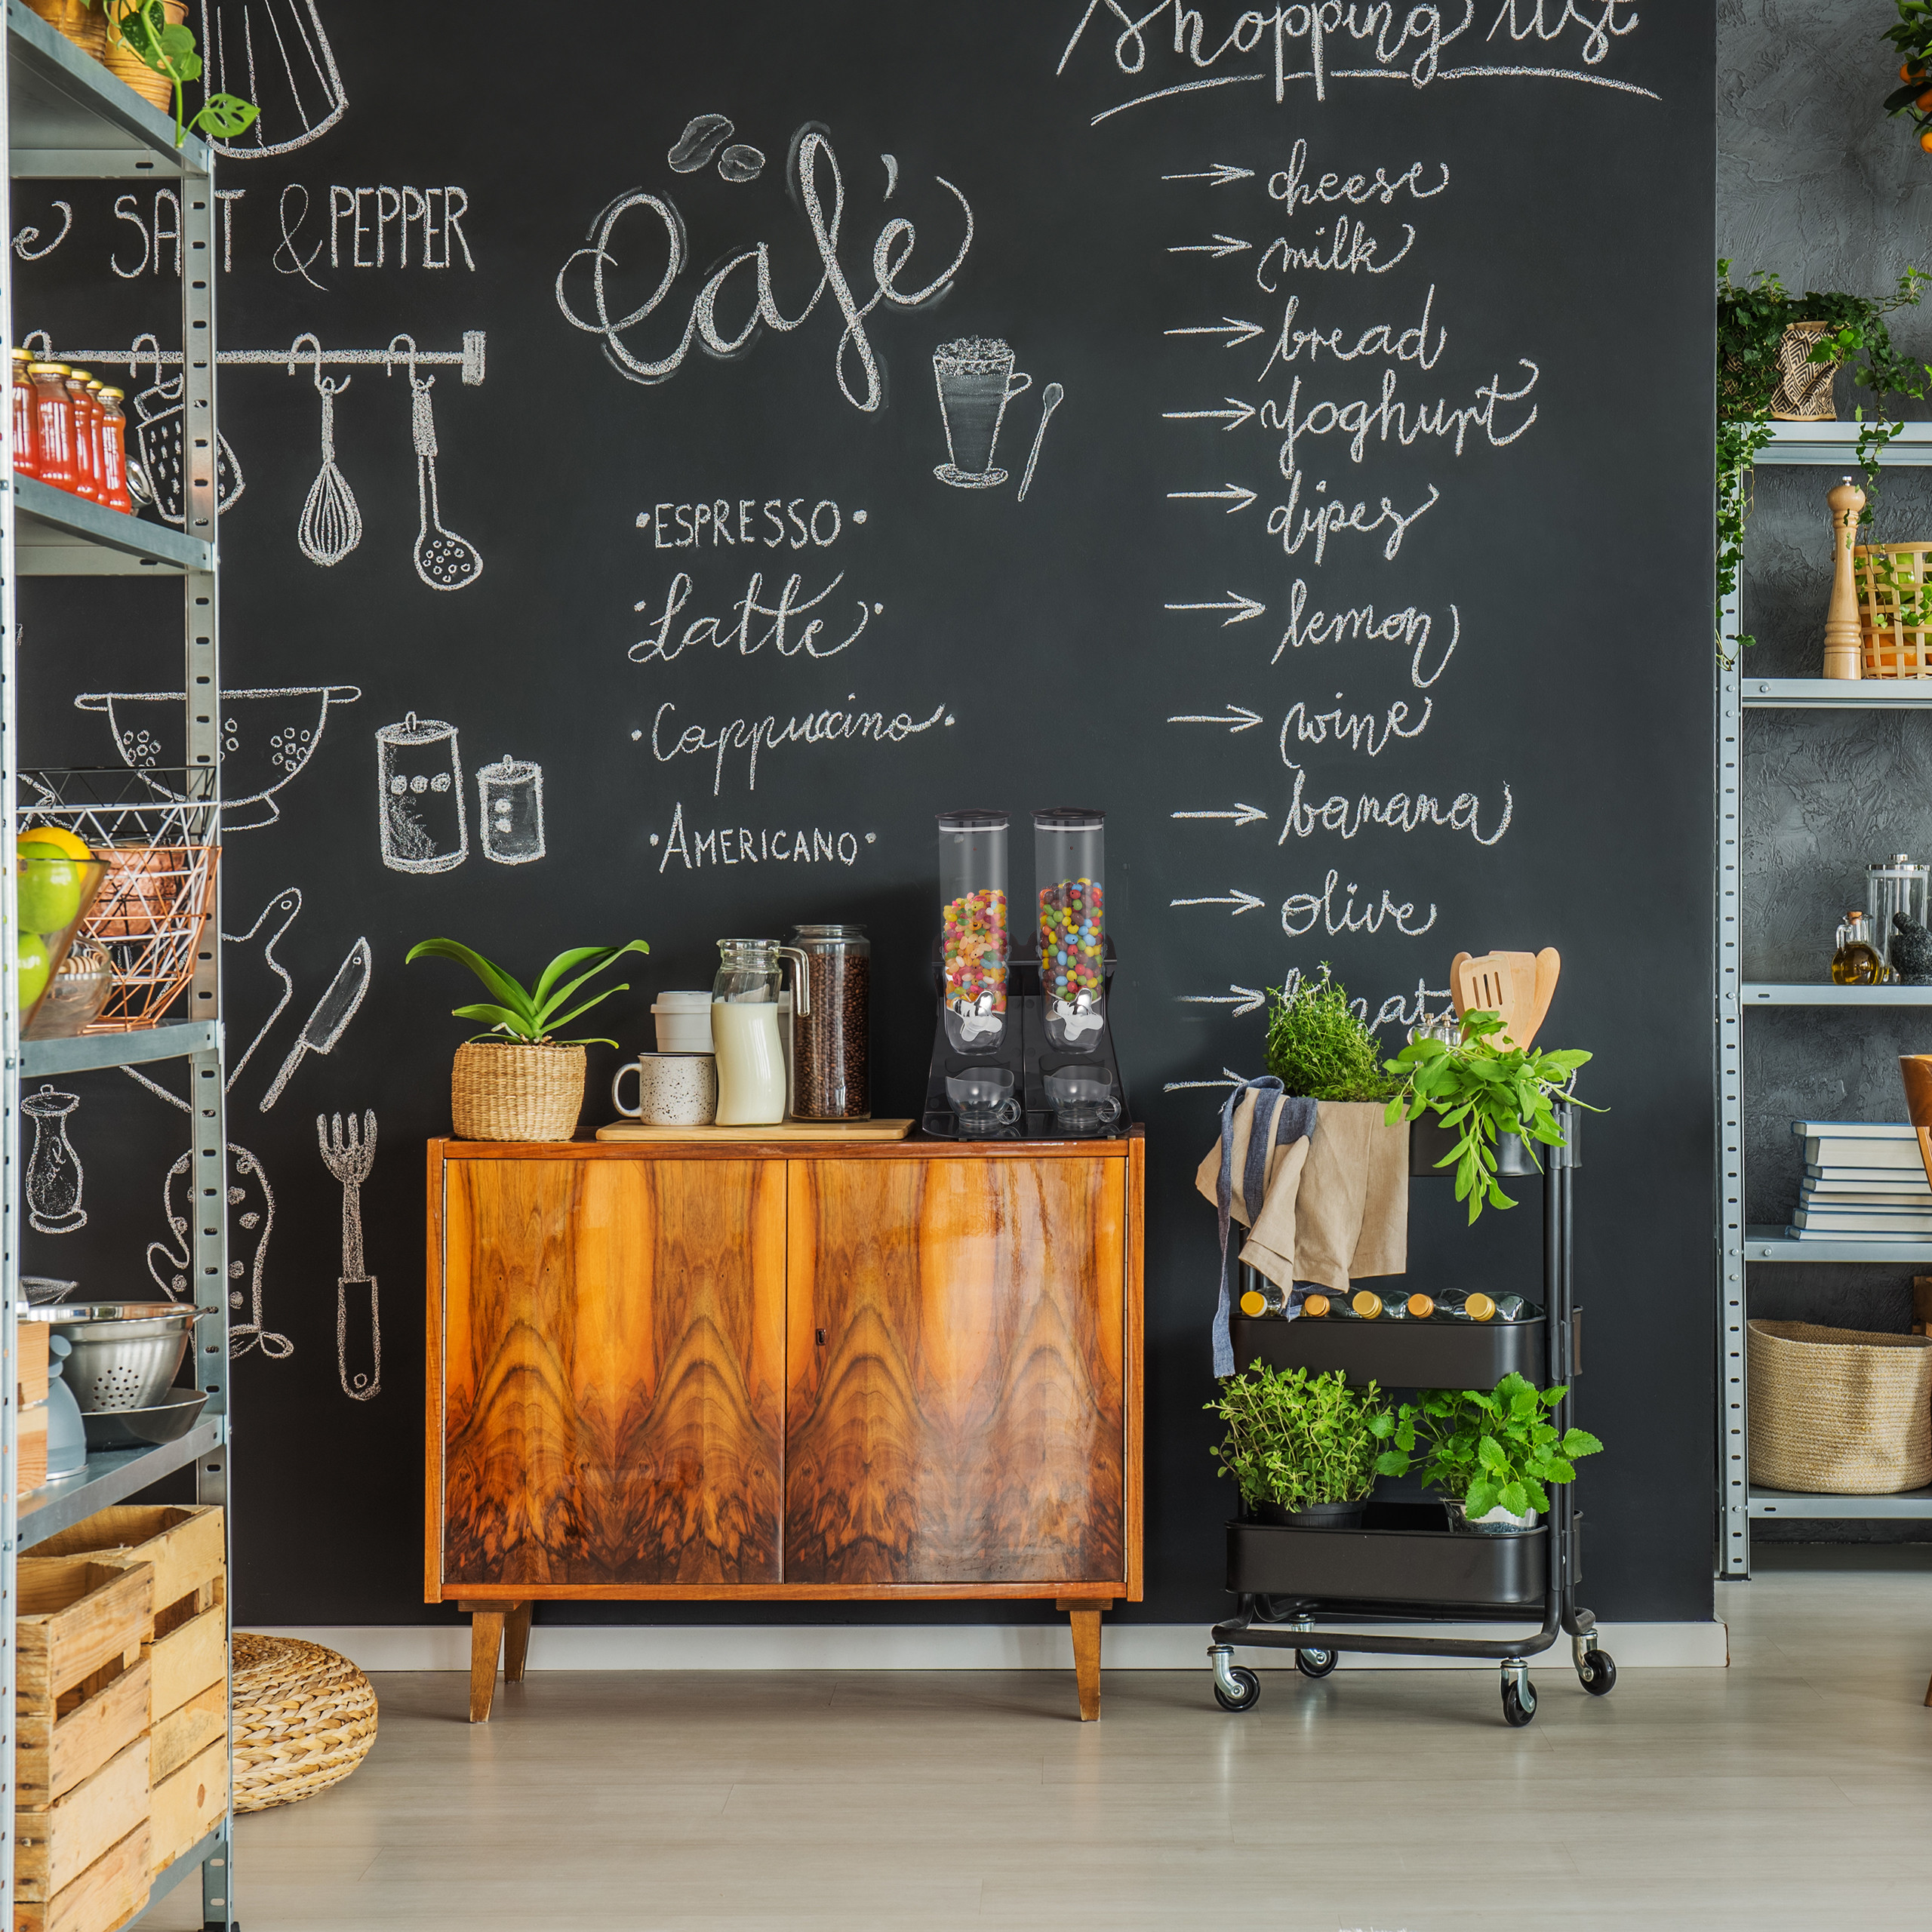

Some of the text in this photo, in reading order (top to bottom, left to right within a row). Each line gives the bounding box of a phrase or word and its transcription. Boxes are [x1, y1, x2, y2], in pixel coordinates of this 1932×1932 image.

[1268, 138, 1449, 216] cheese
[111, 188, 246, 278] SAT
[272, 183, 328, 291] &
[330, 184, 475, 272] PEPPER
[1257, 214, 1416, 293] milk
[1257, 283, 1447, 383] bread
[1259, 358, 1540, 478] yoghurt
[654, 498, 841, 549] ESPRESSO
[628, 569, 869, 663] Latte
[1271, 578, 1460, 688] lemon
[1279, 691, 1433, 768] wine
[1278, 770, 1513, 846] banana
[1281, 869, 1438, 937] olive
